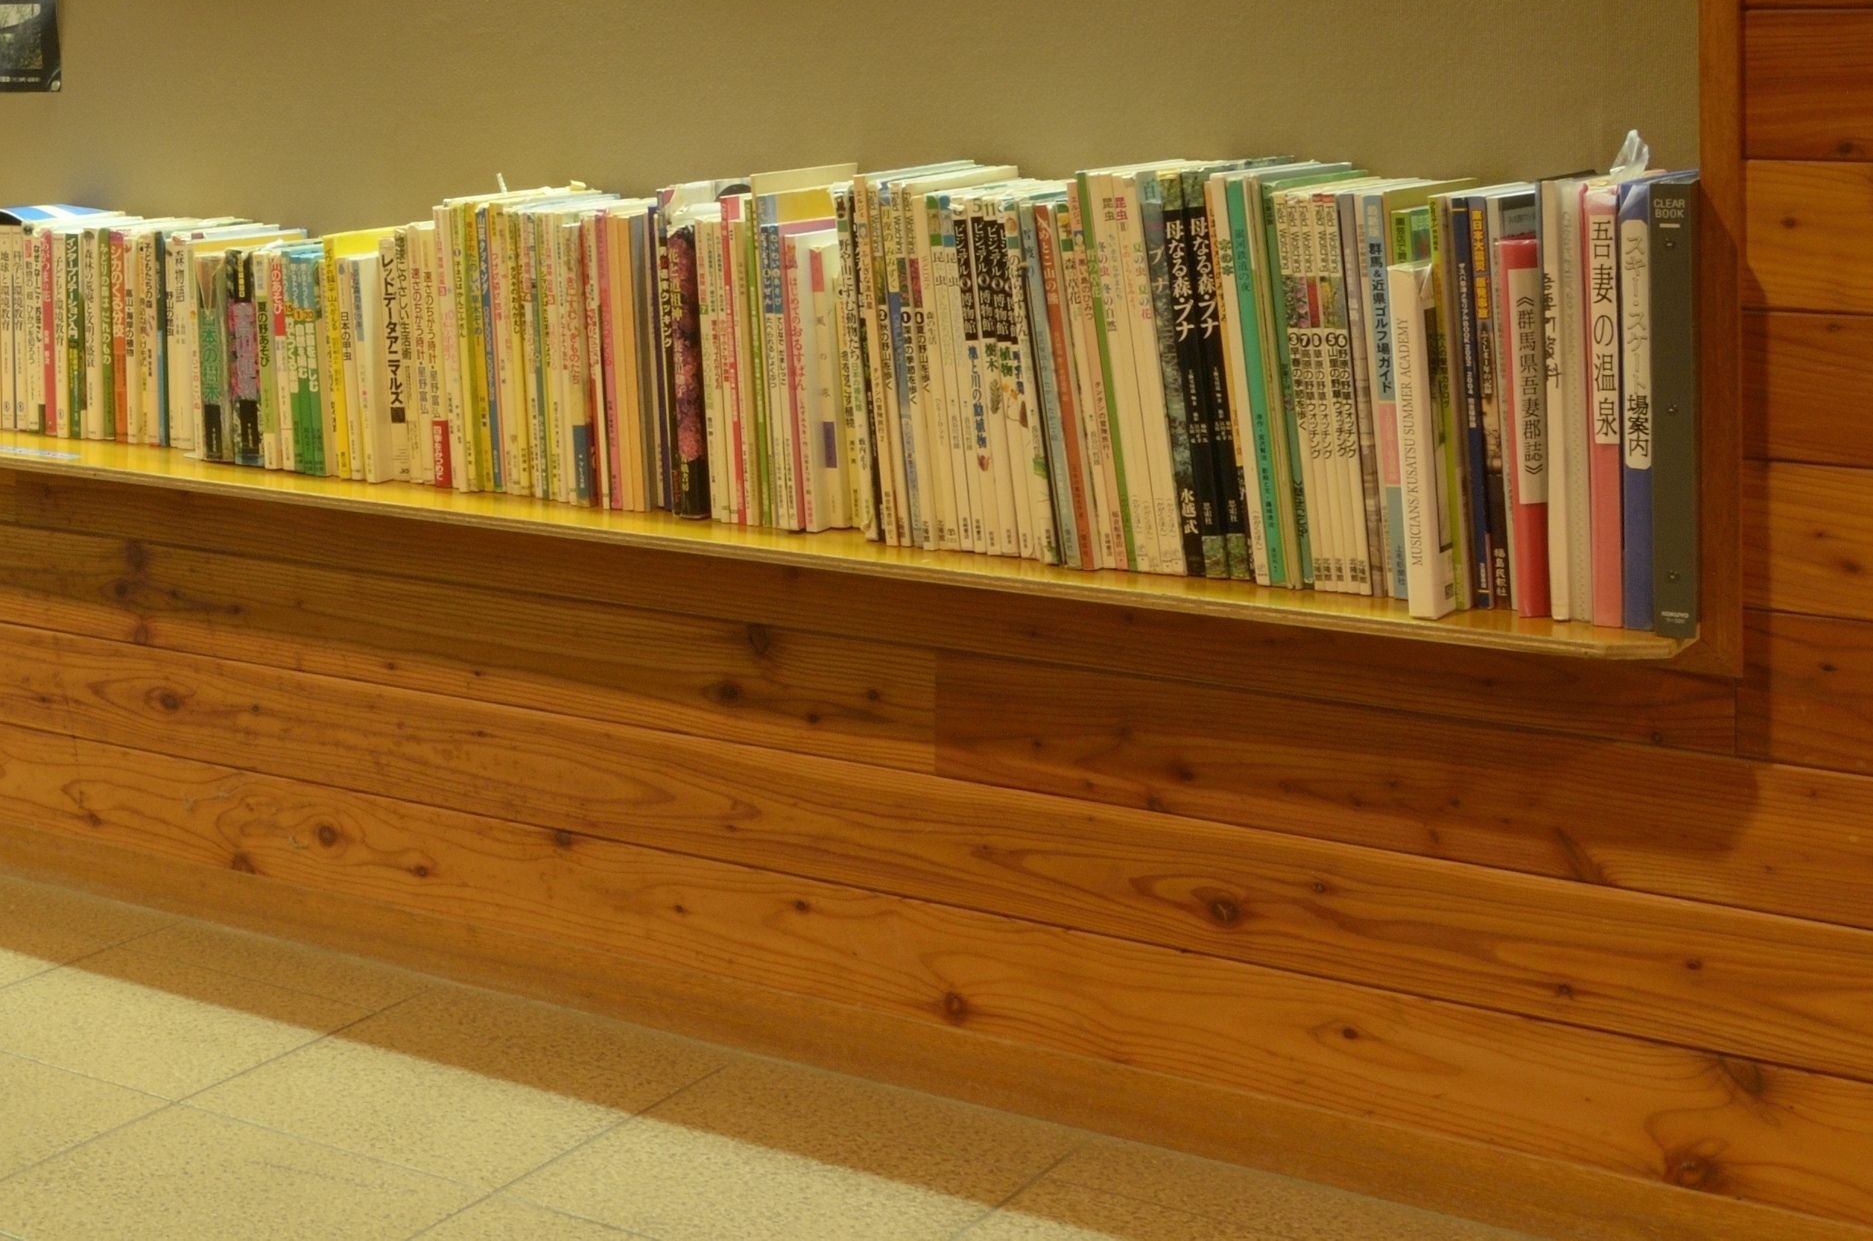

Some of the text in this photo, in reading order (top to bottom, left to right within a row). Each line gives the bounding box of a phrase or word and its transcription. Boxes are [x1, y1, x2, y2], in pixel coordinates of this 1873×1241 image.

[1102, 197, 1115, 222] 昆虫
[1115, 197, 1129, 221] 昆虫
[1471, 209, 1488, 272] 東日本大震災
[1653, 198, 1686, 209] CLEAR
[1654, 208, 1685, 219] BOOK
[0, 252, 10, 331] 地球と環境教育
[13, 250, 23, 331] 科学と環境教育
[110, 245, 125, 338] シカのくる分校
[839, 239, 859, 361] 野や山にすむ動物たち
[974, 222, 995, 333] ビジュアル 博物館
[987, 225, 1009, 336] ビジュアル 博物館
[1133, 242, 1152, 320] 夏の虫 夏の花
[1166, 219, 1195, 342] 母なる森・ブナ
[1190, 216, 1219, 339] 母なる森・ブナ
[1368, 242, 1393, 394] 群馬&近県ゴルフ場ガイド
[258, 301, 270, 368] 夏の野あそび
[341, 312, 352, 361] 日本の甲虫
[381, 254, 403, 404] レッドデータアニマルズ
[1592, 219, 1618, 440] 吾妻の温泉
[1622, 234, 1651, 460] スキー・スケート場案内
[1396, 318, 1424, 566] MUSICIANS/KUSATSU SUMMER ACADEMY
